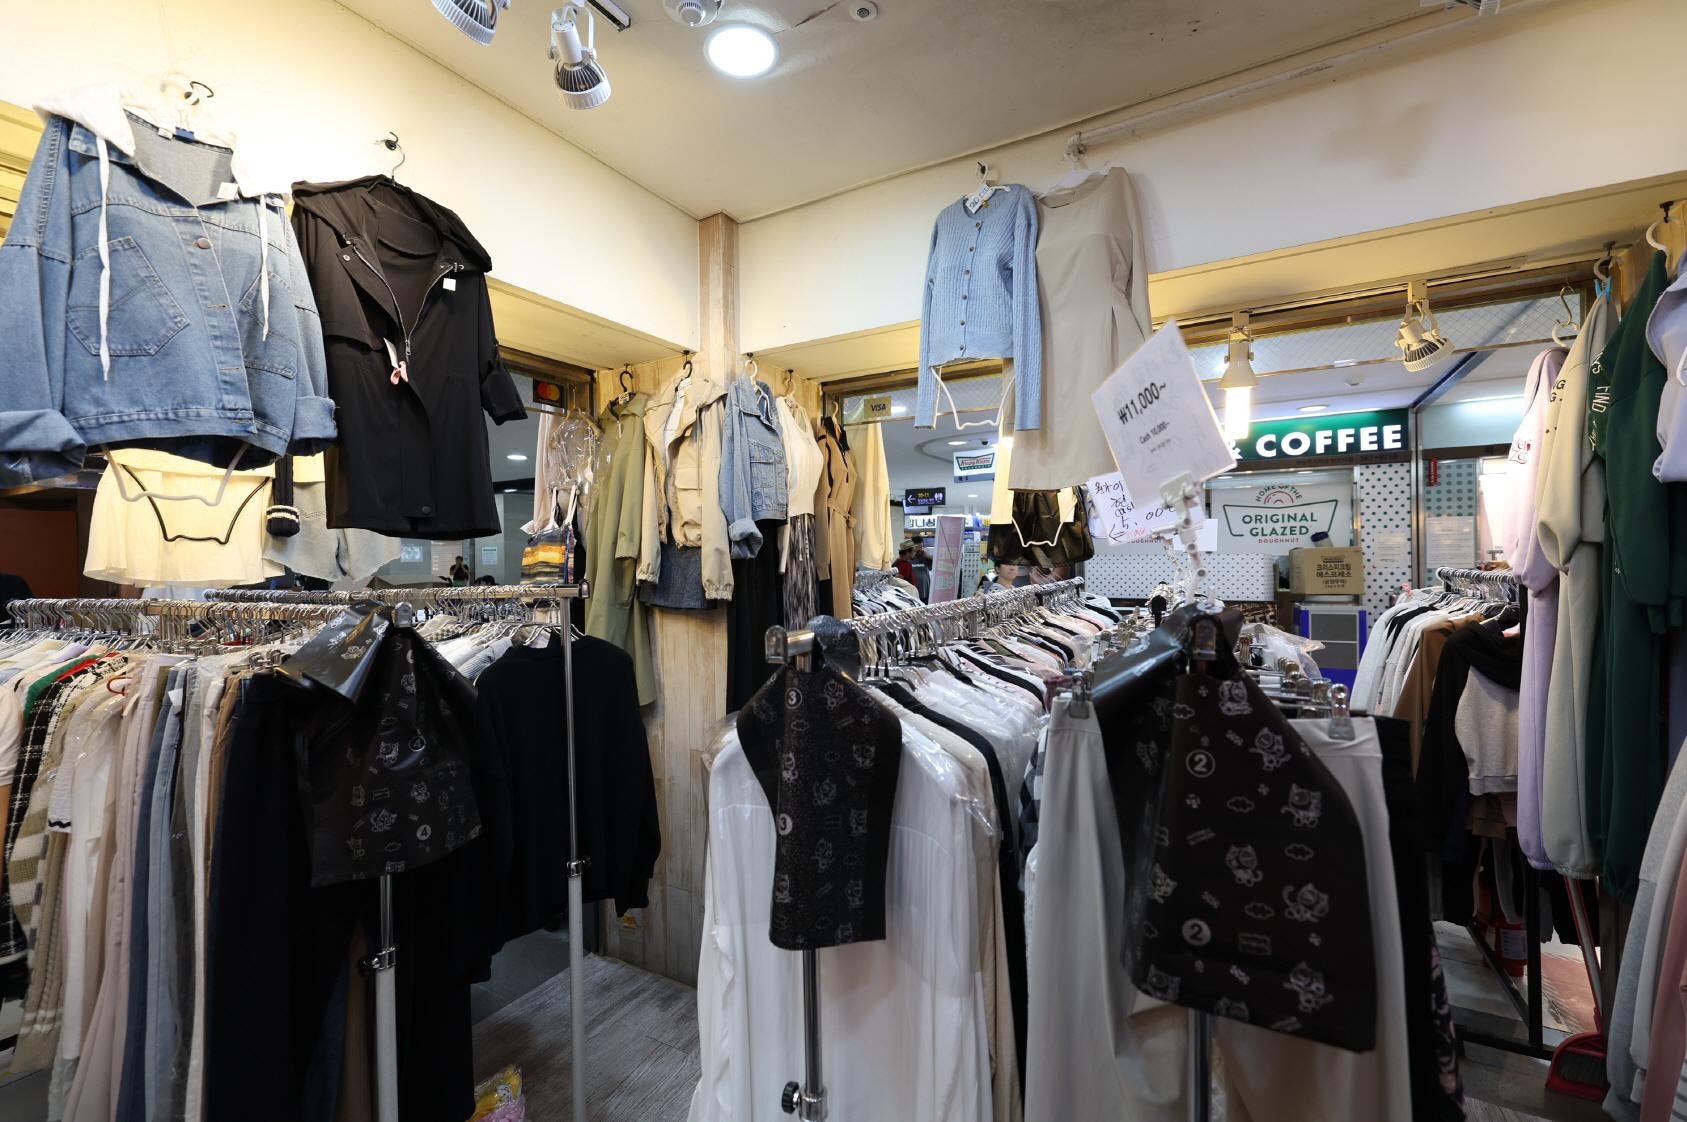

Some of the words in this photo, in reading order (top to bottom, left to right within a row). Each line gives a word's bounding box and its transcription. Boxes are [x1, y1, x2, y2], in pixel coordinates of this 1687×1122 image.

[1591, 385, 1611, 413] FIND
[870, 403, 887, 412] VISA
[1255, 424, 1402, 458] COFFEE
[1255, 485, 1277, 502] HOME
[1291, 486, 1303, 500] THE
[1242, 512, 1318, 525] ORIGINAL
[1249, 525, 1310, 537] GLAZED
